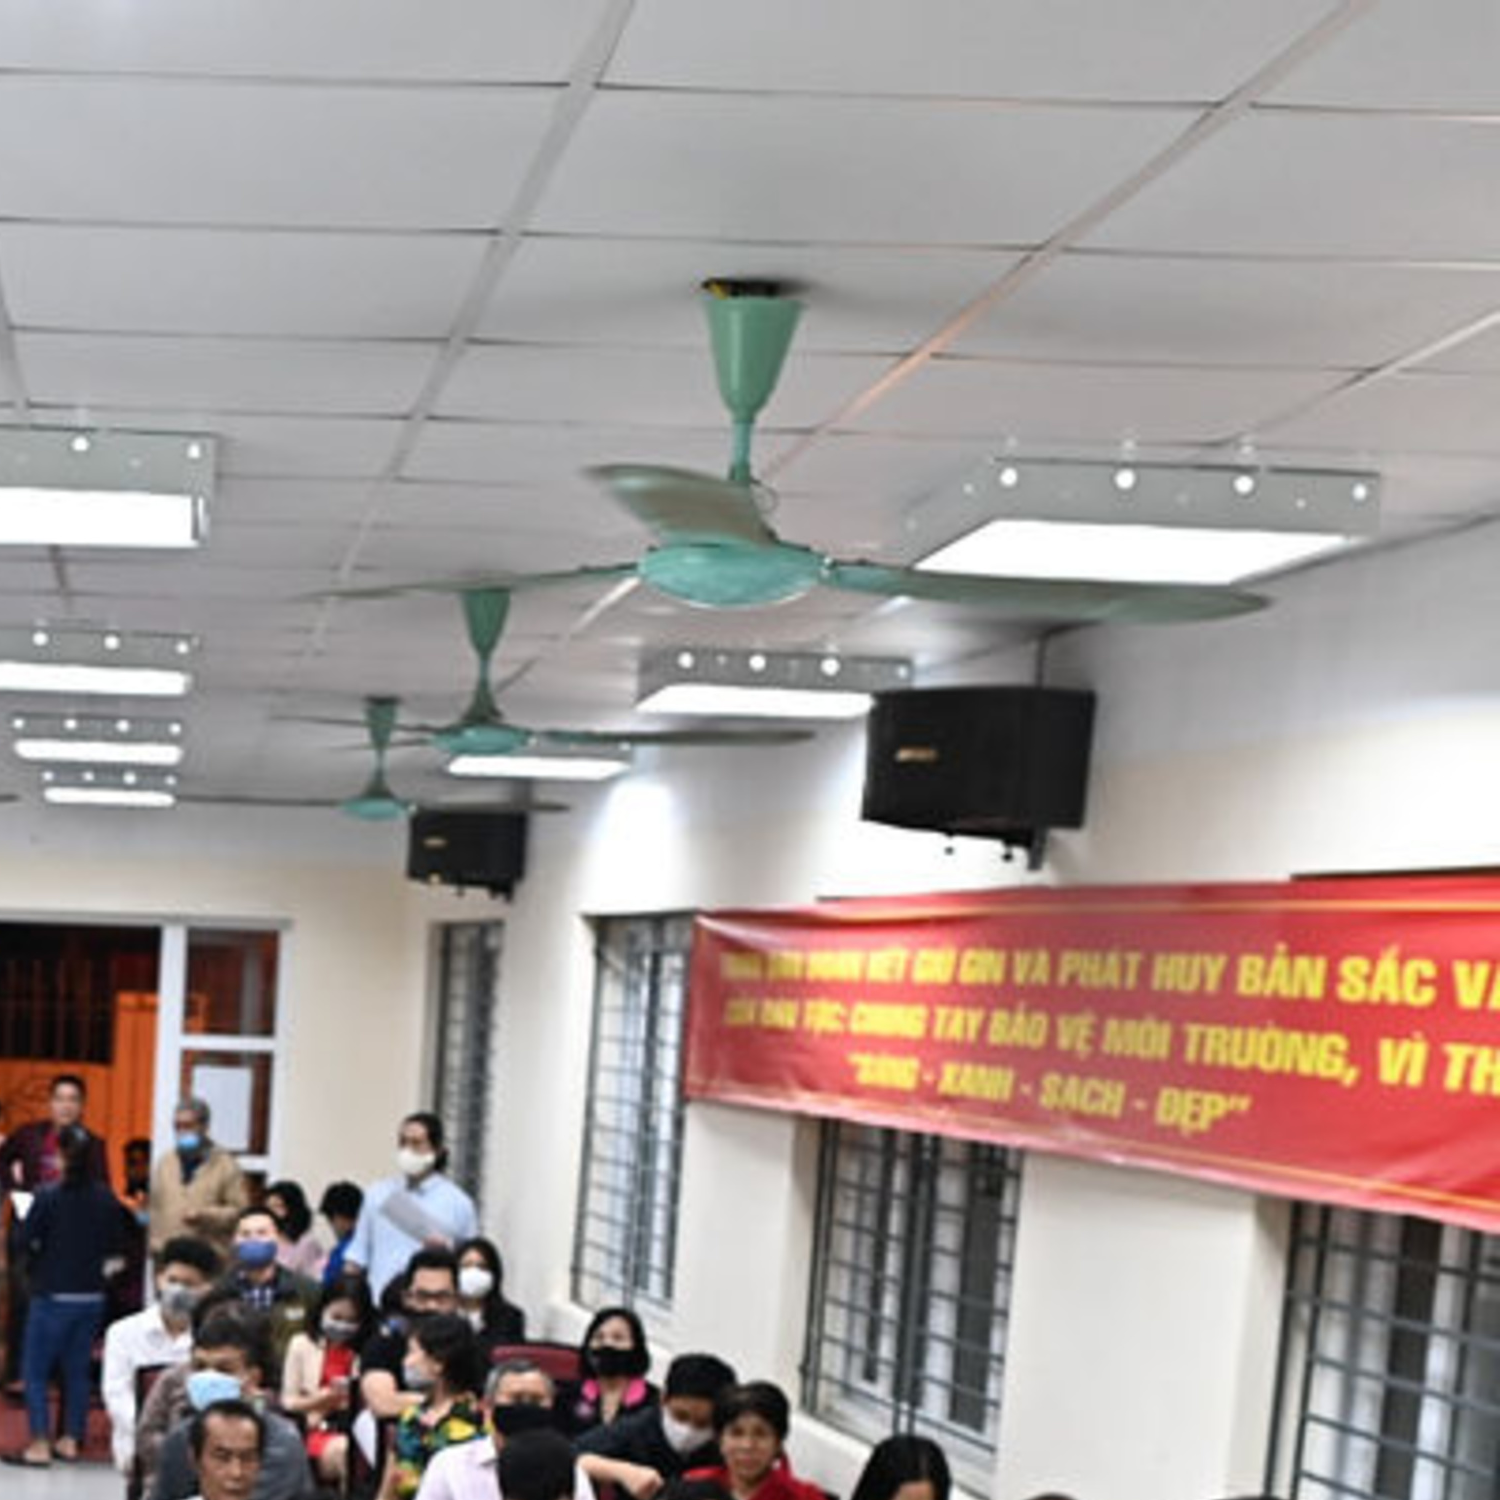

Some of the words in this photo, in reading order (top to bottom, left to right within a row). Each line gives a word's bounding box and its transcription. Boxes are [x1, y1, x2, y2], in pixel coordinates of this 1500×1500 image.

[1013, 948, 1049, 986] VÀ
[1058, 946, 1142, 990] PHÁT
[1152, 951, 1226, 993] HUY
[1237, 942, 1327, 998] BẢN
[1337, 944, 1438, 1006] SẮC
[932, 1006, 984, 1042] TAY
[987, 1001, 1048, 1049] BẢO
[1057, 1010, 1096, 1060] VỆ
[1103, 1014, 1170, 1060] MÔI
[1184, 1021, 1359, 1087] TRƯỜNG,
[1378, 1031, 1427, 1087] VÌ
